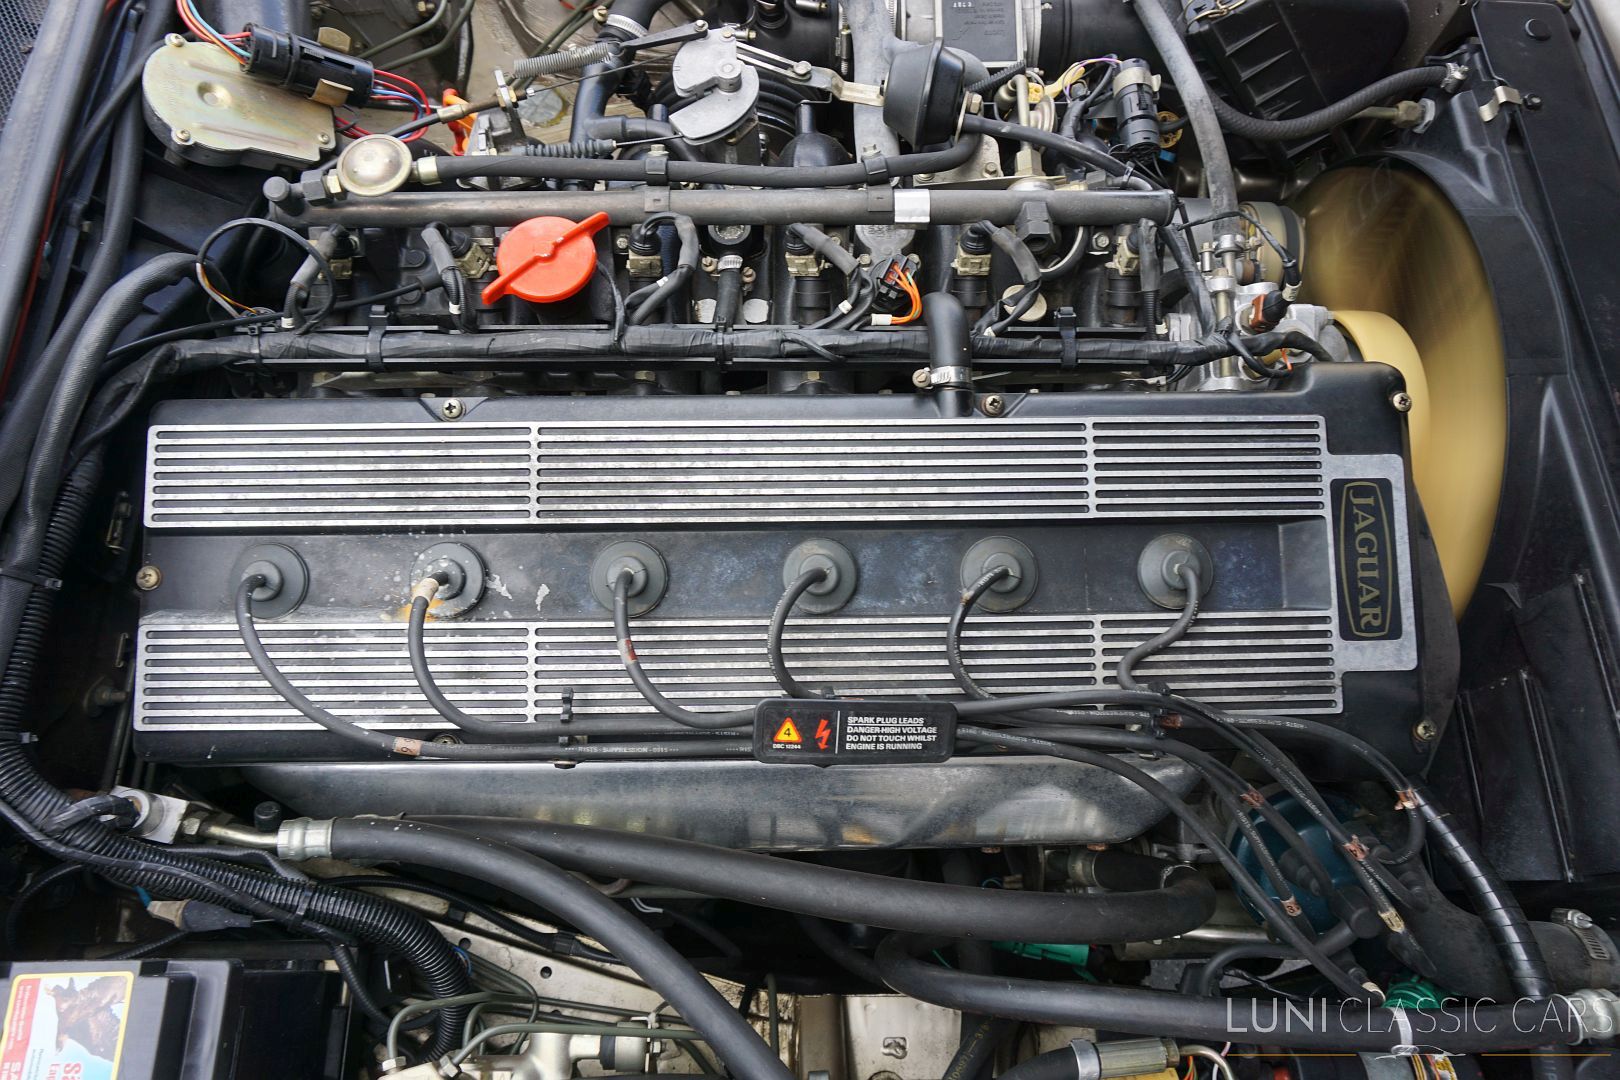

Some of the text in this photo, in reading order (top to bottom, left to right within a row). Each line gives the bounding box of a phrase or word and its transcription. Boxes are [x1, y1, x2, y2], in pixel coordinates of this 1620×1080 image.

[1349, 489, 1382, 630] JAGUAR
[847, 716, 875, 724] SPARK
[783, 727, 792, 737] 4
[901, 726, 938, 734] VOLTAGE
[846, 734, 938, 742] DO NOT TOUCH WHILST
